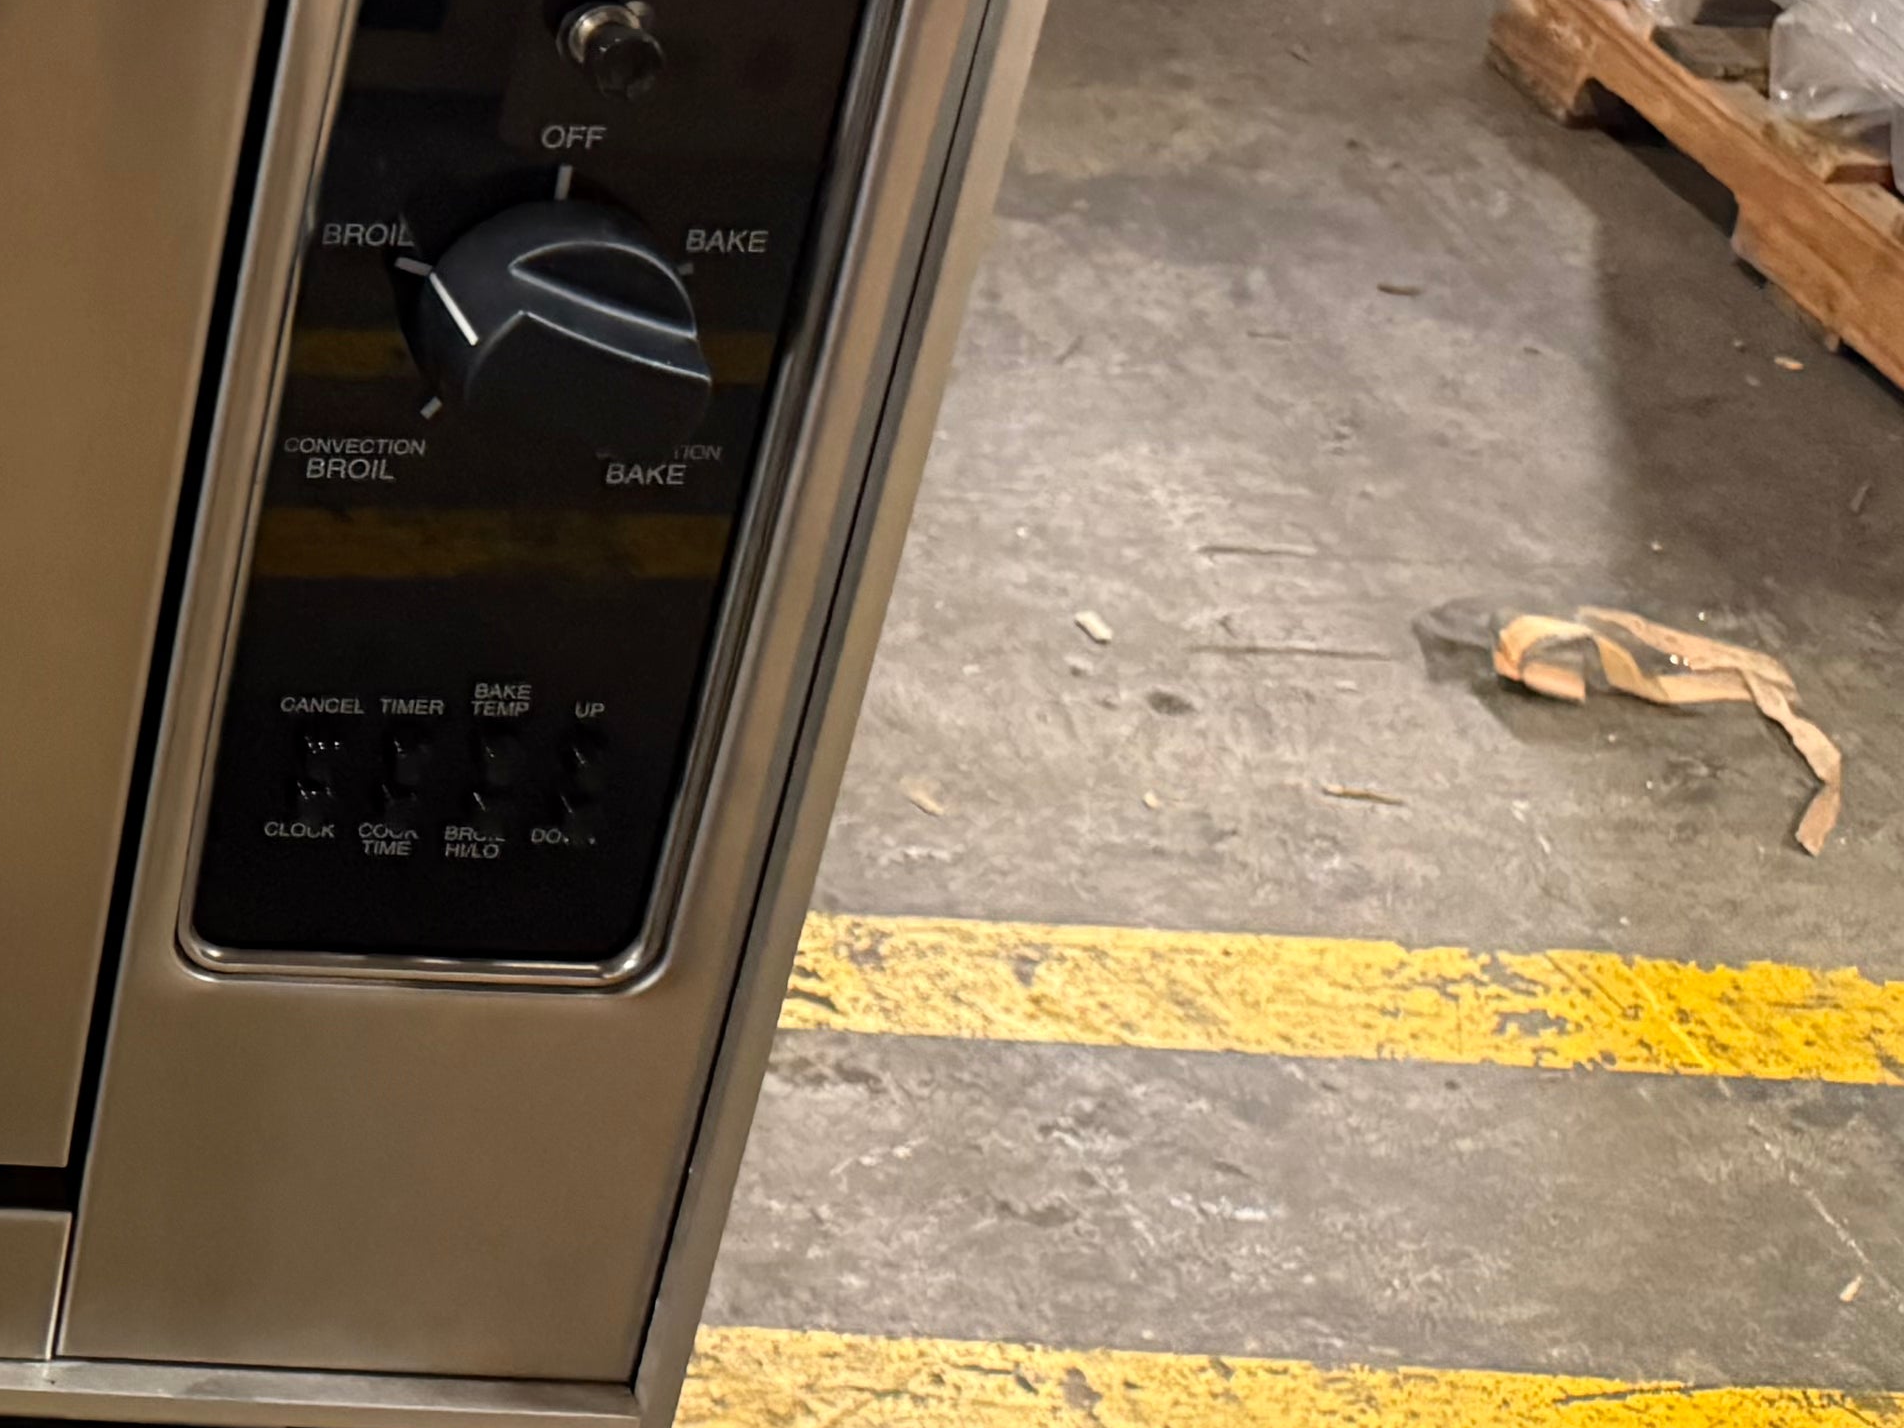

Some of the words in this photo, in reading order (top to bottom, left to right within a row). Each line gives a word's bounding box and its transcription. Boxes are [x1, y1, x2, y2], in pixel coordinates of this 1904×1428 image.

[541, 125, 607, 150] OFF
[322, 222, 415, 247] BROIL
[686, 228, 769, 254] BAKE
[284, 436, 426, 456] CONVECTION
[306, 456, 397, 482] BROIL
[605, 462, 686, 486] BAKE
[474, 682, 533, 701] BAKE
[280, 696, 365, 715] CANCEL
[379, 697, 445, 716] TIMER
[471, 699, 531, 718] TEMP
[574, 701, 606, 719] UP
[530, 827, 597, 845] DO
[361, 839, 413, 857] TIME
